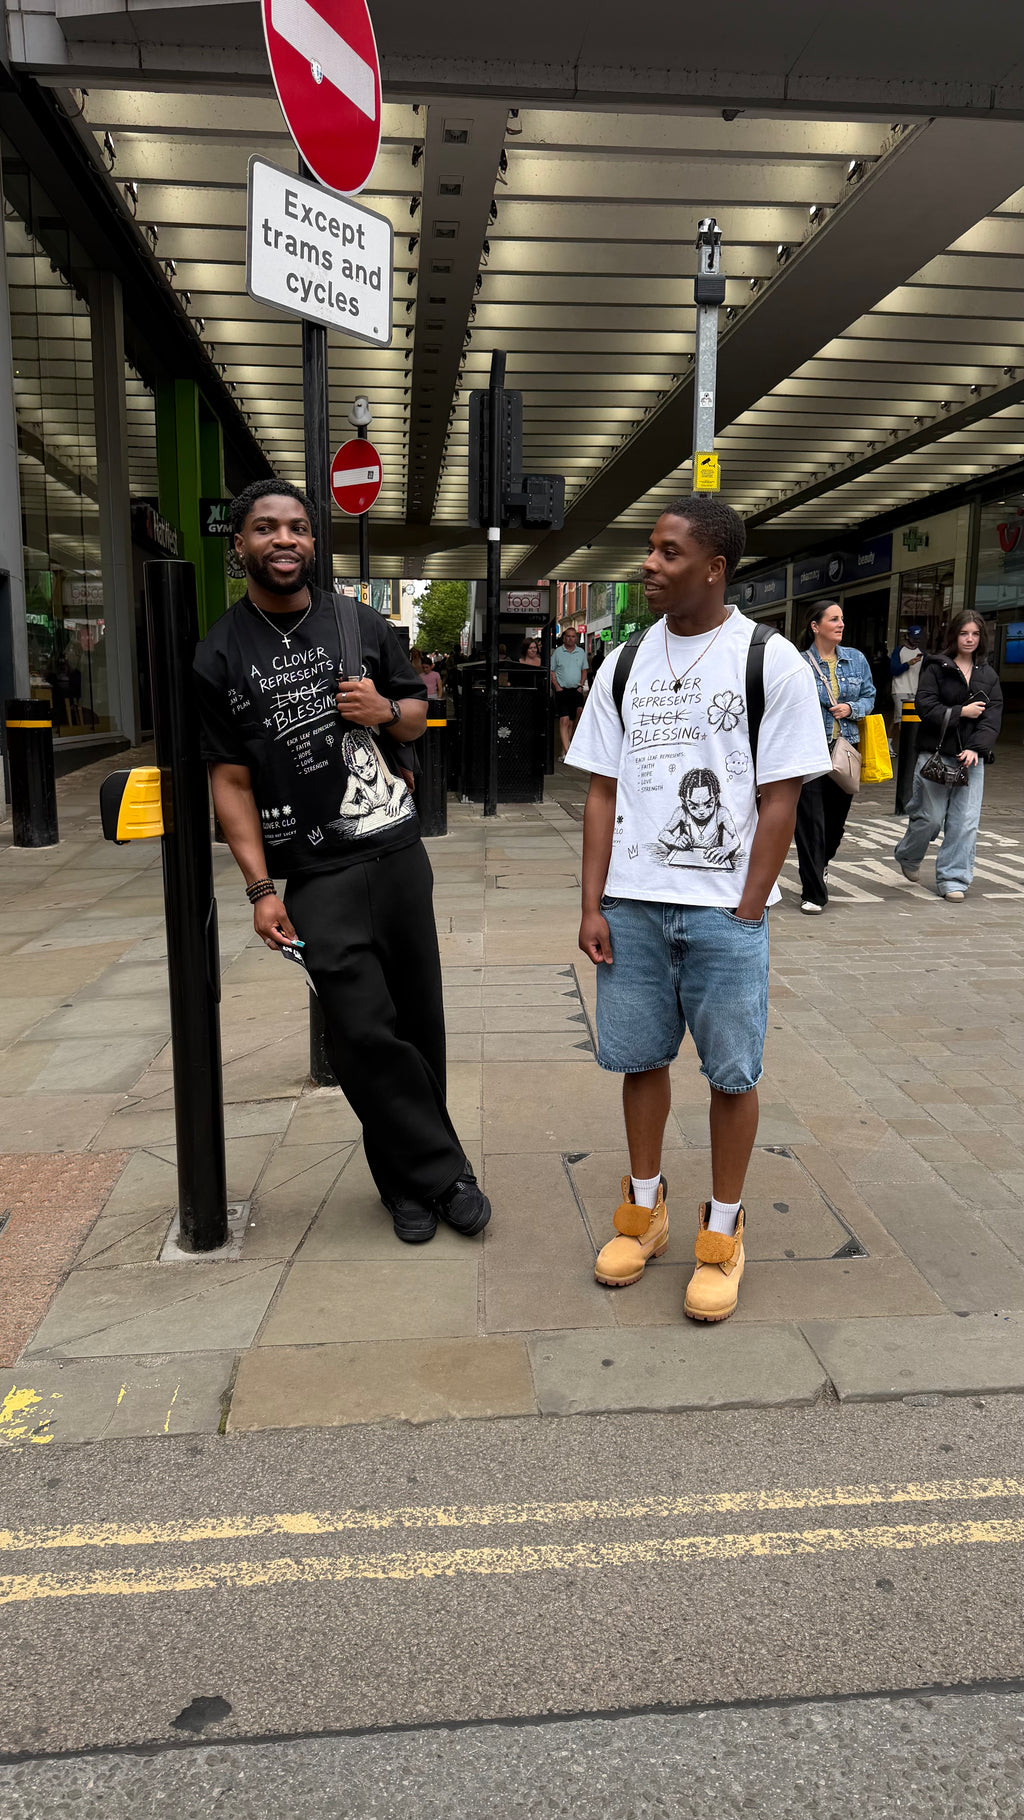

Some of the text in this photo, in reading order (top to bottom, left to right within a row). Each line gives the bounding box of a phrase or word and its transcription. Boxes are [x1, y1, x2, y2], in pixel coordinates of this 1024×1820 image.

[284, 188, 366, 250] Except
[261, 218, 382, 291] trams and
[286, 272, 360, 317] cycles
[507, 592, 541, 608] food
[250, 646, 330, 679] A CLOVER
[258, 659, 334, 693] REPRESENTS
[276, 678, 328, 708] LUCK
[630, 682, 638, 695] A
[631, 693, 702, 710] REPRESENTS
[640, 708, 692, 726] LUCK
[300, 731, 311, 741] LEAF
[630, 726, 701, 747] BLESSING
[296, 740, 311, 752] FAITH
[298, 749, 312, 760] HOPE
[300, 757, 314, 767] LOVE
[303, 760, 329, 775] STRENGTH
[281, 818, 296, 827] CLO
